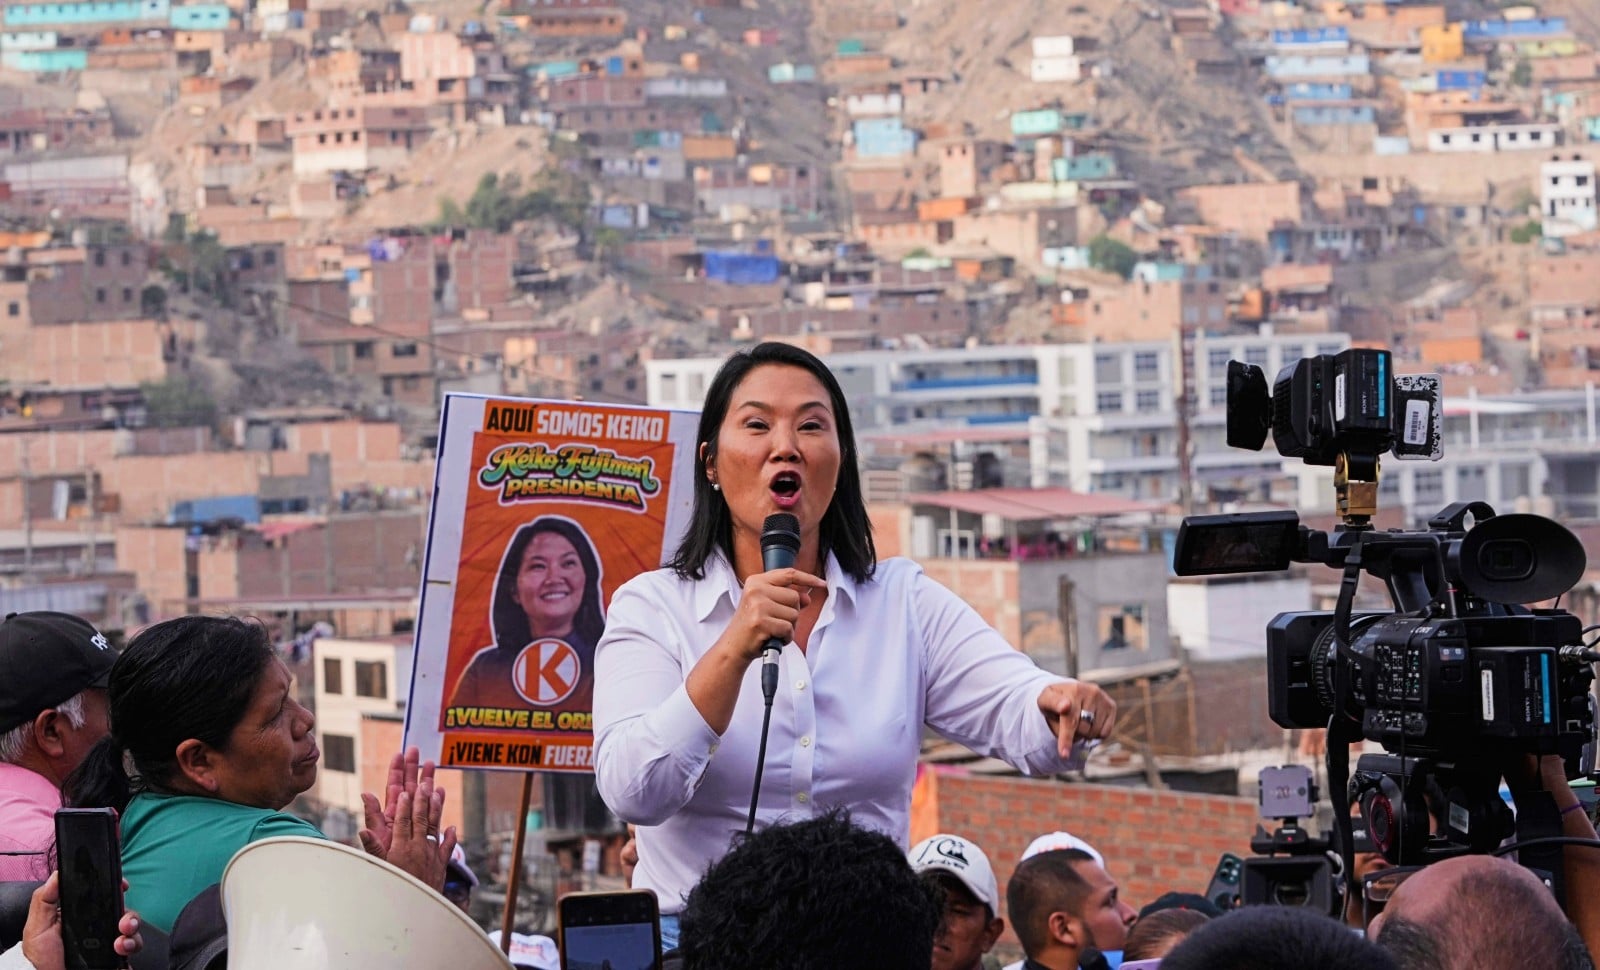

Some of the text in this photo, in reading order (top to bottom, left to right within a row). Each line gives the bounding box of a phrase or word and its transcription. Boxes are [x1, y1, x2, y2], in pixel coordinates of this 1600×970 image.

[486, 404, 665, 443] AQUÍ SOMOS KEIKO
[482, 445, 558, 483] Keiko
[504, 478, 641, 505] PRESIDENTA
[524, 642, 571, 701] K
[446, 708, 529, 728] ¡VUELVE
[531, 711, 554, 729] EL
[449, 741, 504, 765] ¡VIENE
[506, 743, 542, 764] KON
